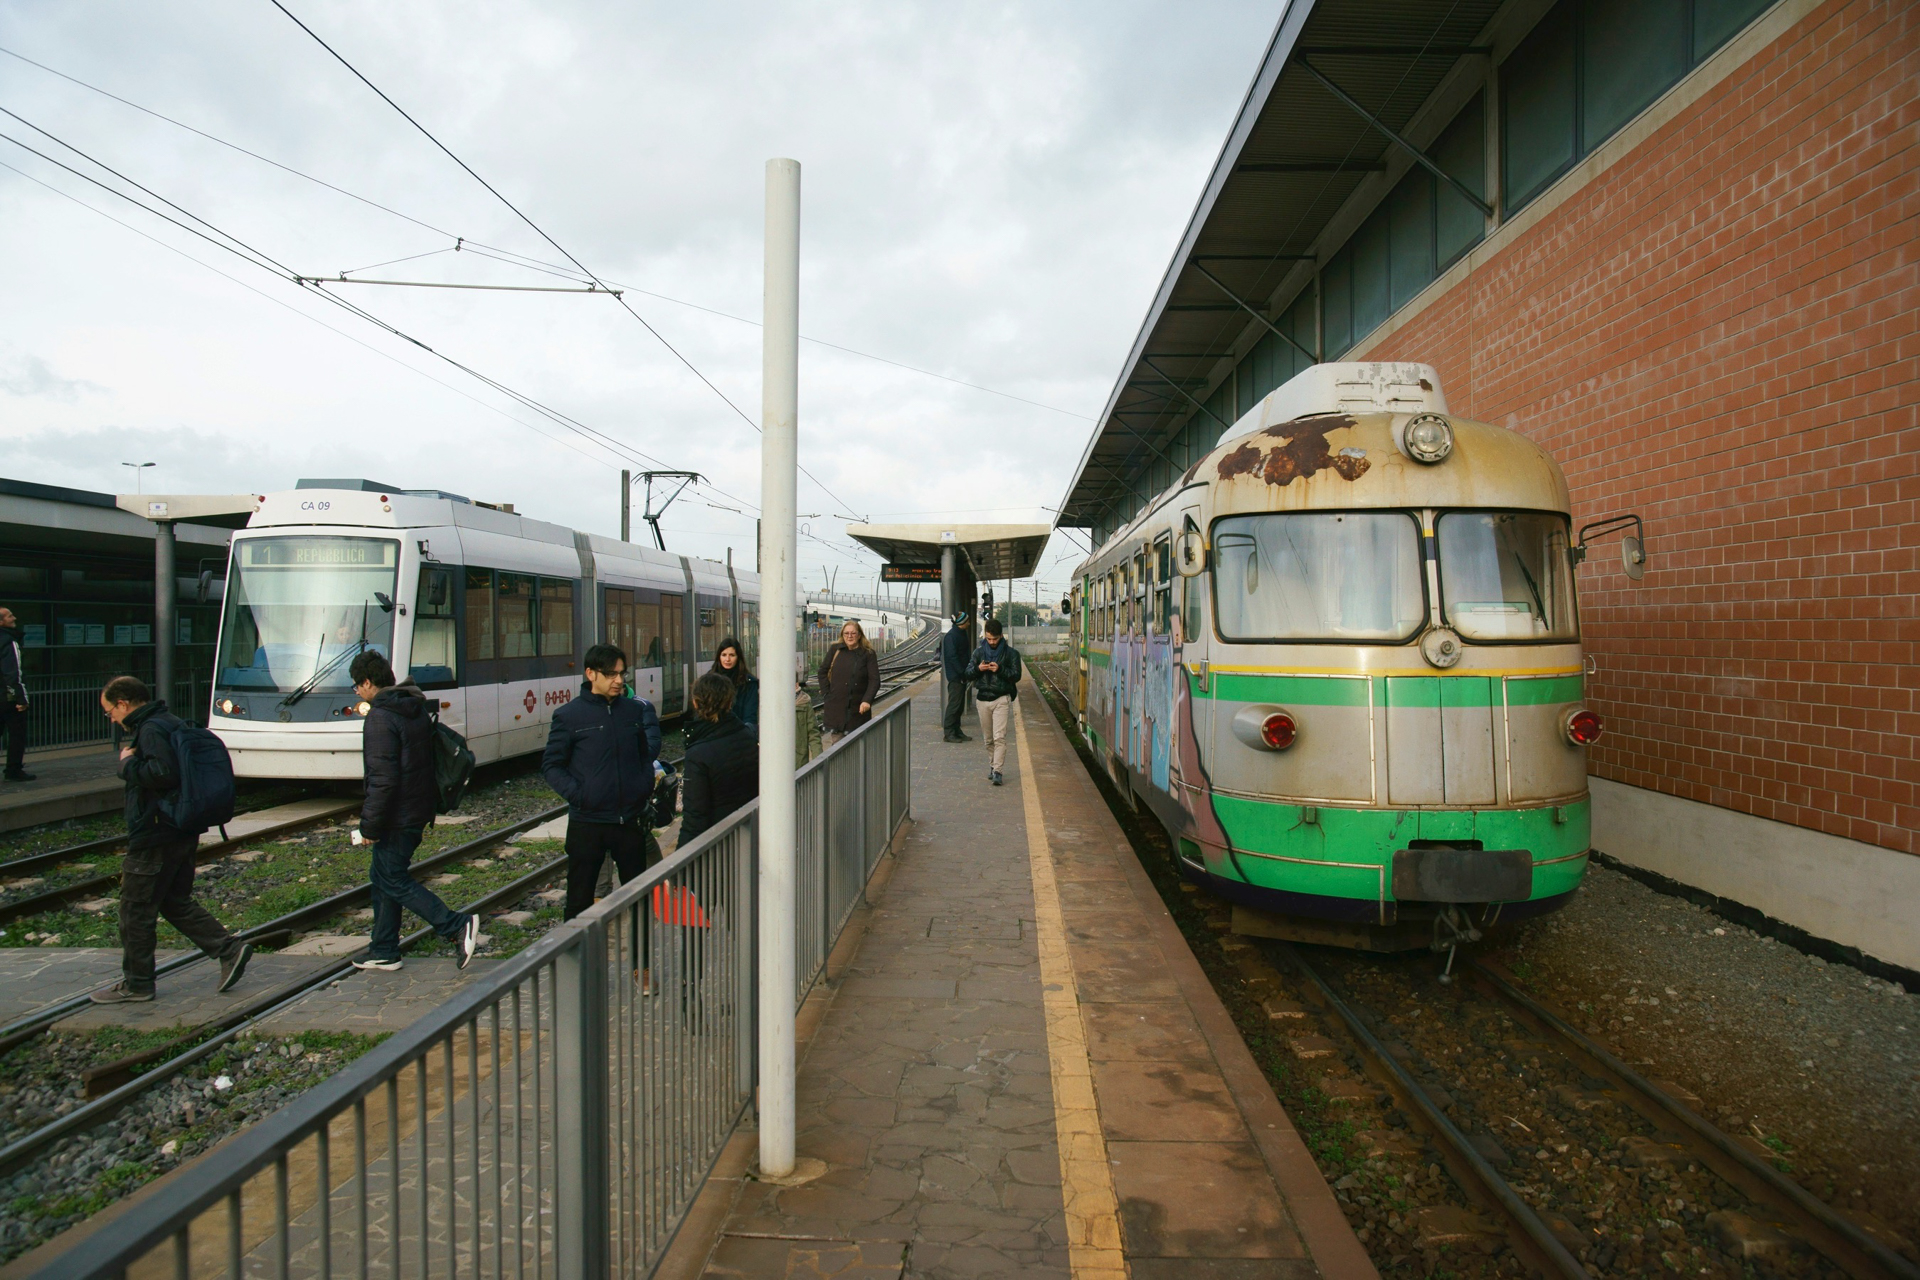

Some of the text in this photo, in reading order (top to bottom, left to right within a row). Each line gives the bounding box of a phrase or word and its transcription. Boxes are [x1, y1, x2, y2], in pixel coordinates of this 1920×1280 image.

[301, 501, 331, 511] CA 09
[263, 545, 365, 564] 1 REPUBBLICA
